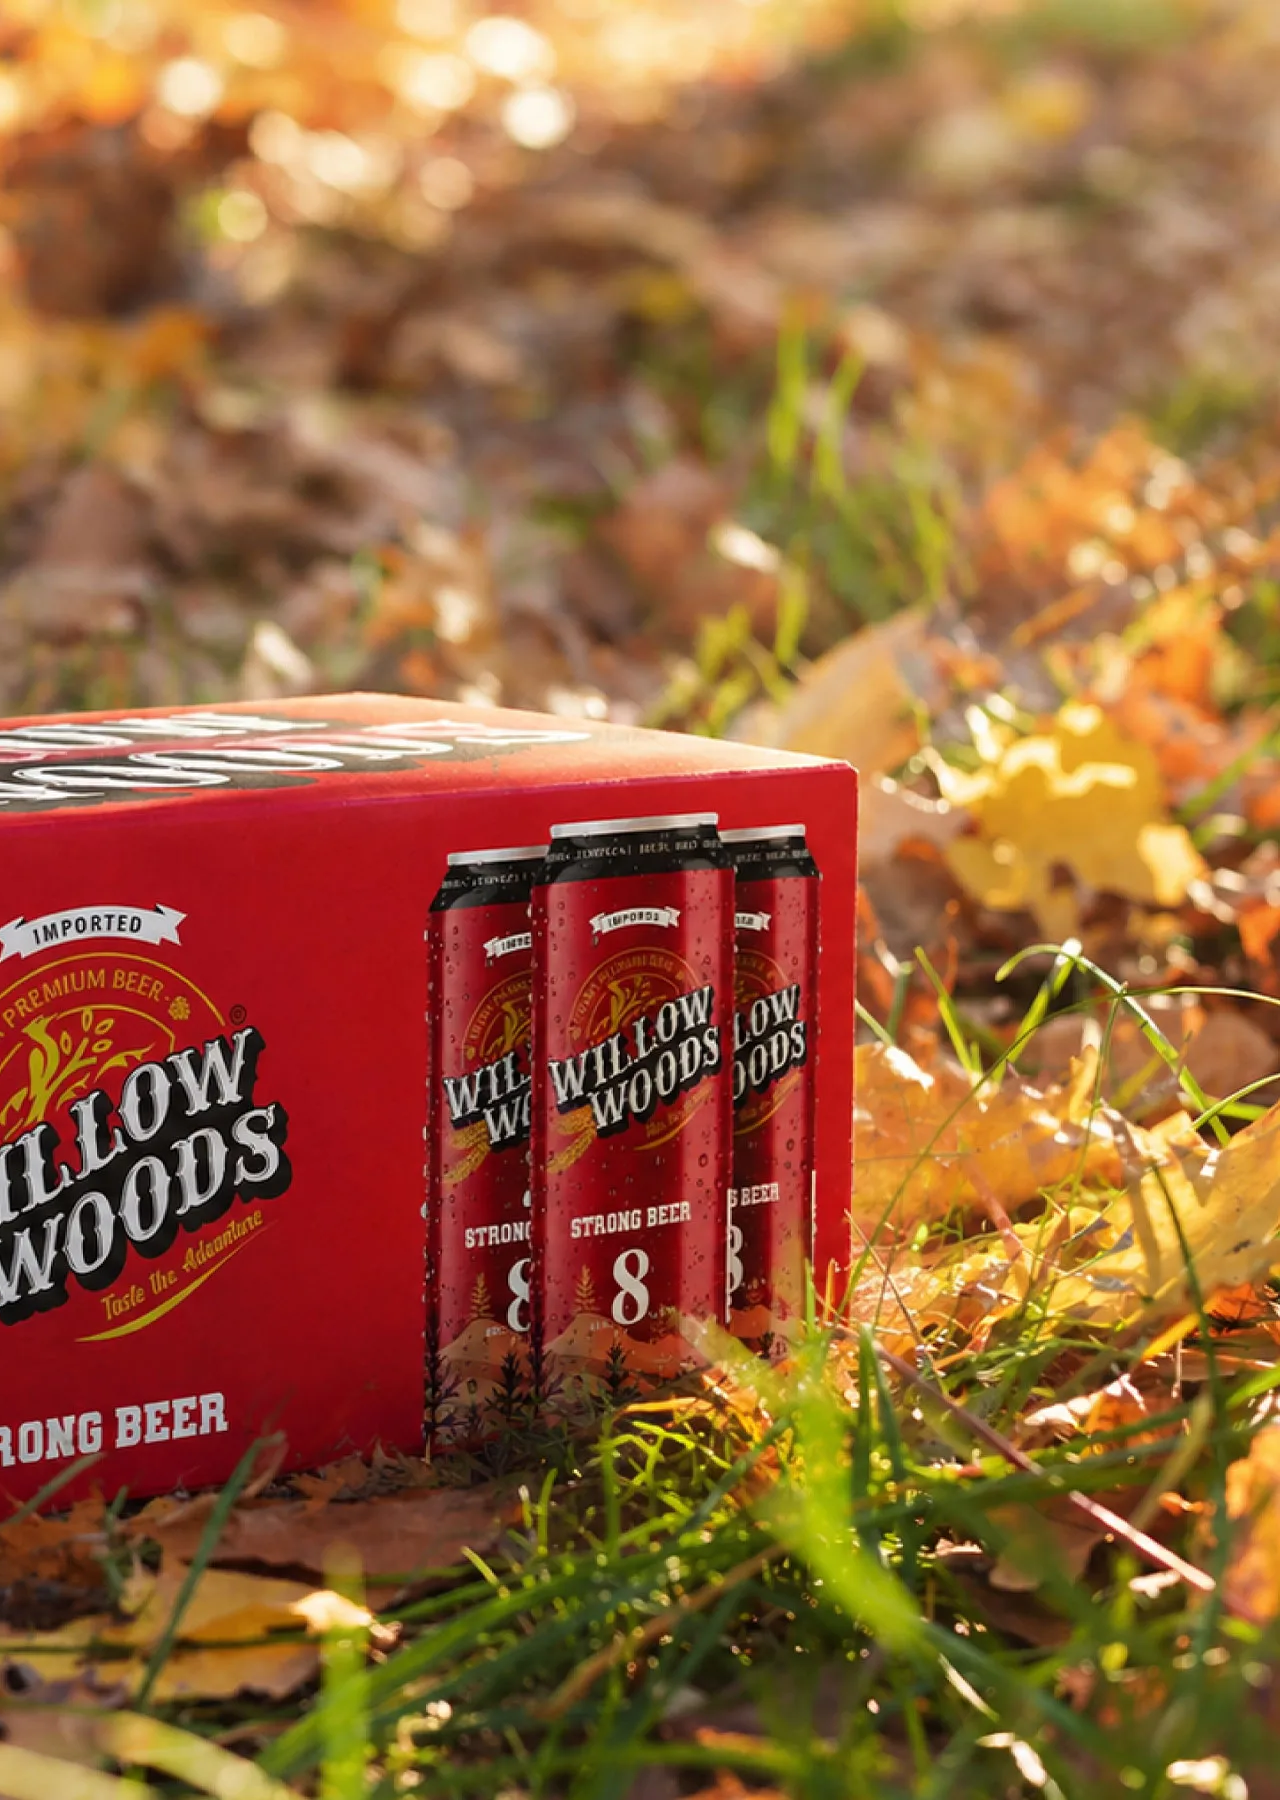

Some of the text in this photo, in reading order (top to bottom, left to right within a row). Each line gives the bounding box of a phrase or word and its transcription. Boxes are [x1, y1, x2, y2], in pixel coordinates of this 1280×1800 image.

[32, 914, 143, 945] IMPORTED
[2, 968, 106, 1029] PREMIUM
[112, 968, 162, 1001] BEER
[548, 985, 711, 1105] WILLOW
[586, 1026, 719, 1129] WOODS
[570, 1200, 692, 1239] STRONG BEER
[611, 1247, 650, 1326] 8
[114, 1392, 229, 1449] BEER
